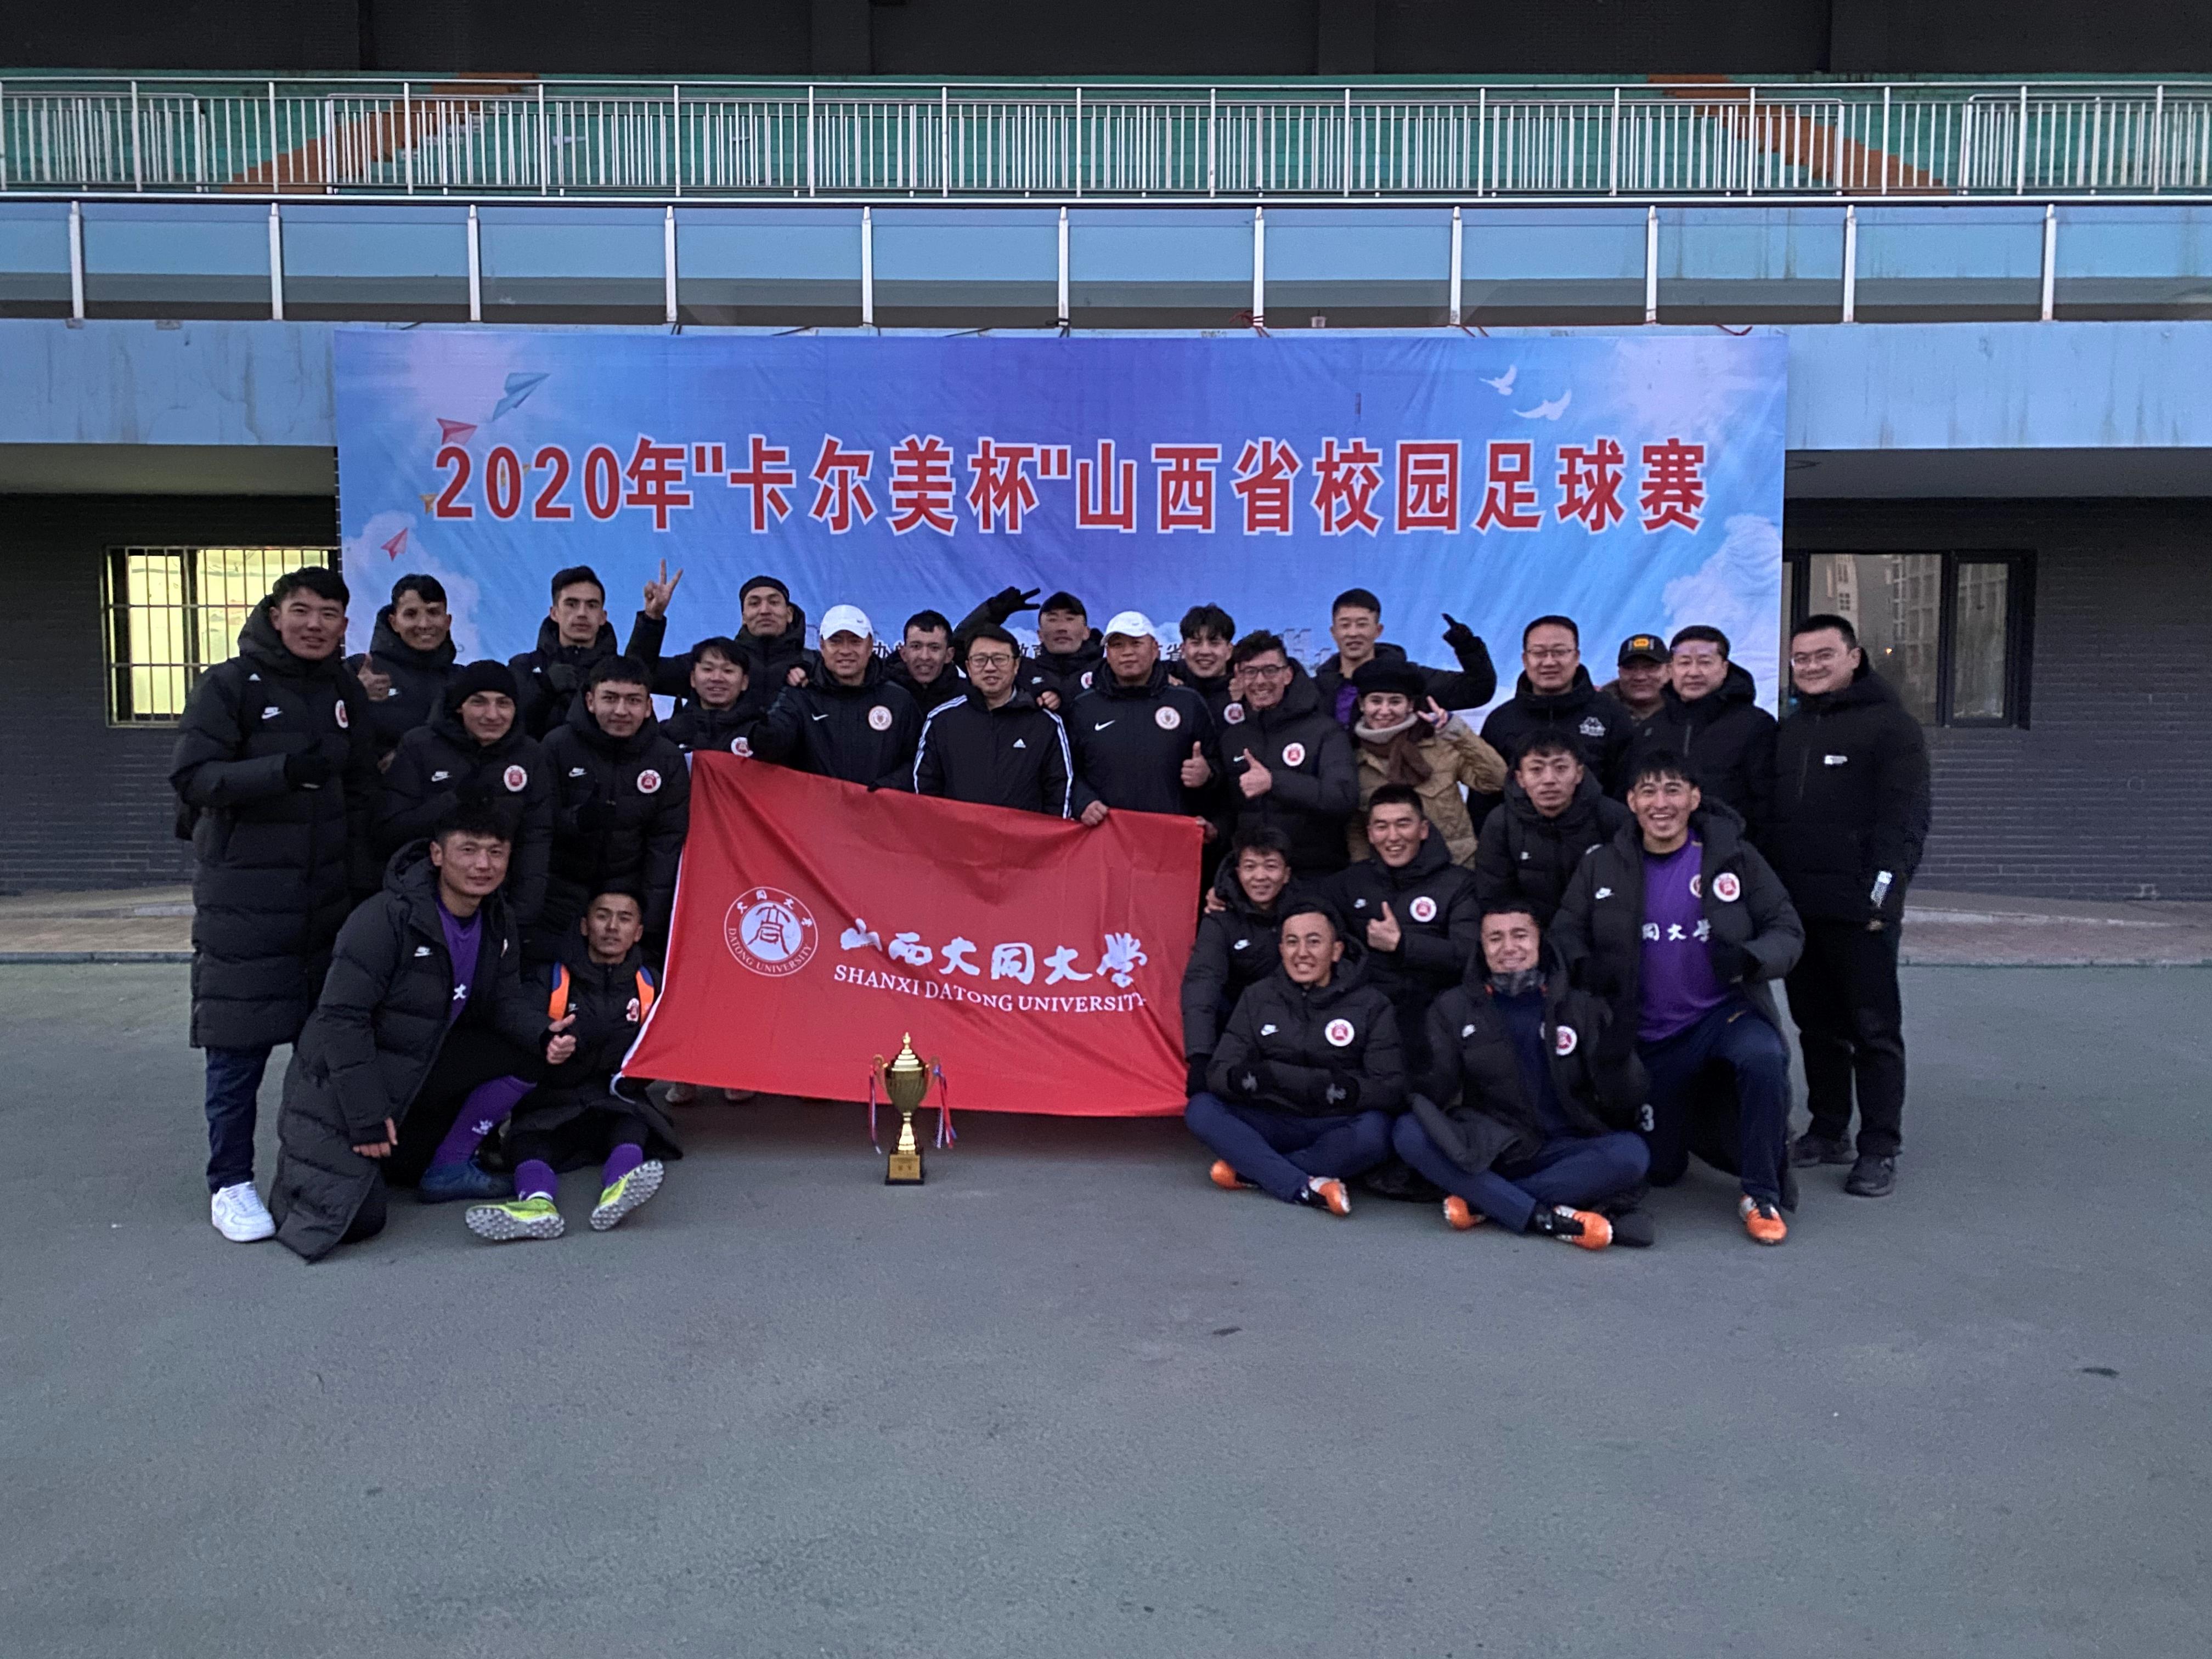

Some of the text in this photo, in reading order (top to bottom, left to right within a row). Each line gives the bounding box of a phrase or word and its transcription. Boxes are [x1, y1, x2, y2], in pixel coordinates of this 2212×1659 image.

[727, 928, 813, 974] DATONG UNIVERSITY
[833, 964, 919, 996] SHANXI
[925, 980, 1013, 1012] DATONG
